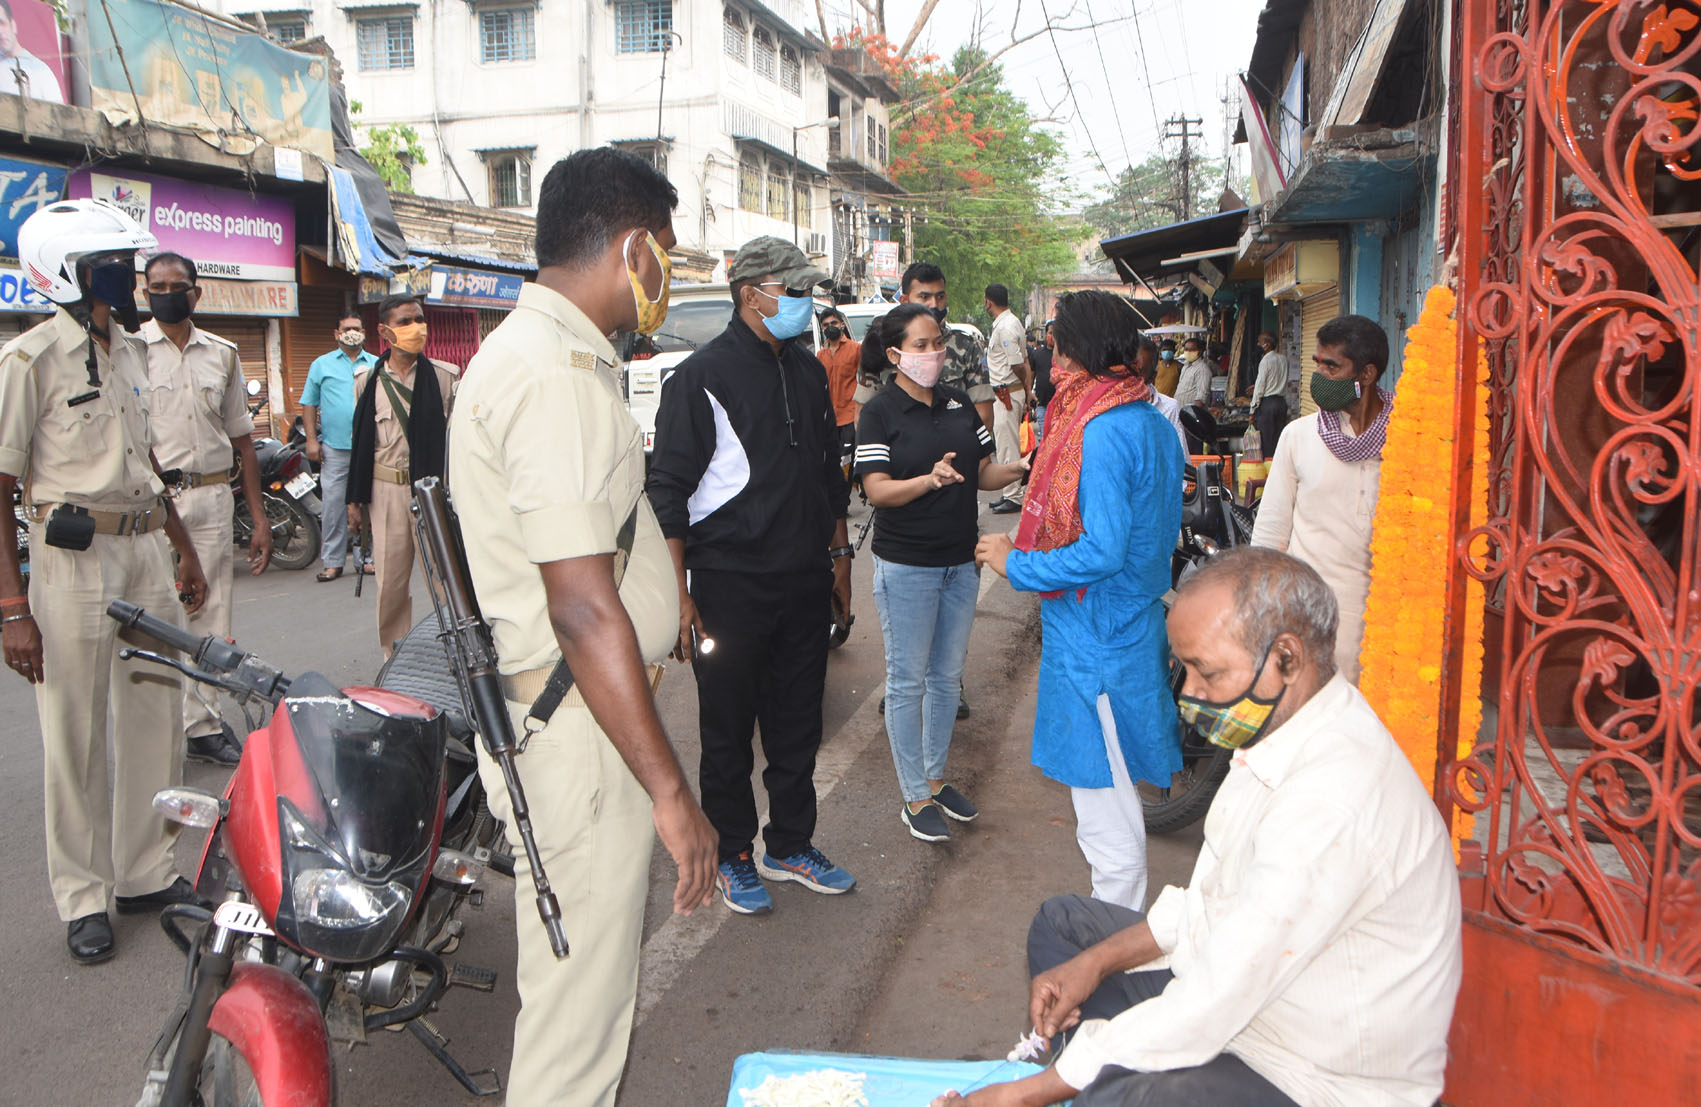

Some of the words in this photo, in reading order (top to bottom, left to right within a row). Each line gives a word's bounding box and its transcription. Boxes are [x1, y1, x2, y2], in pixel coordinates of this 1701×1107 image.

[155, 202, 223, 232] express
[225, 215, 283, 245] painting
[197, 262, 241, 275] HARDWARE
